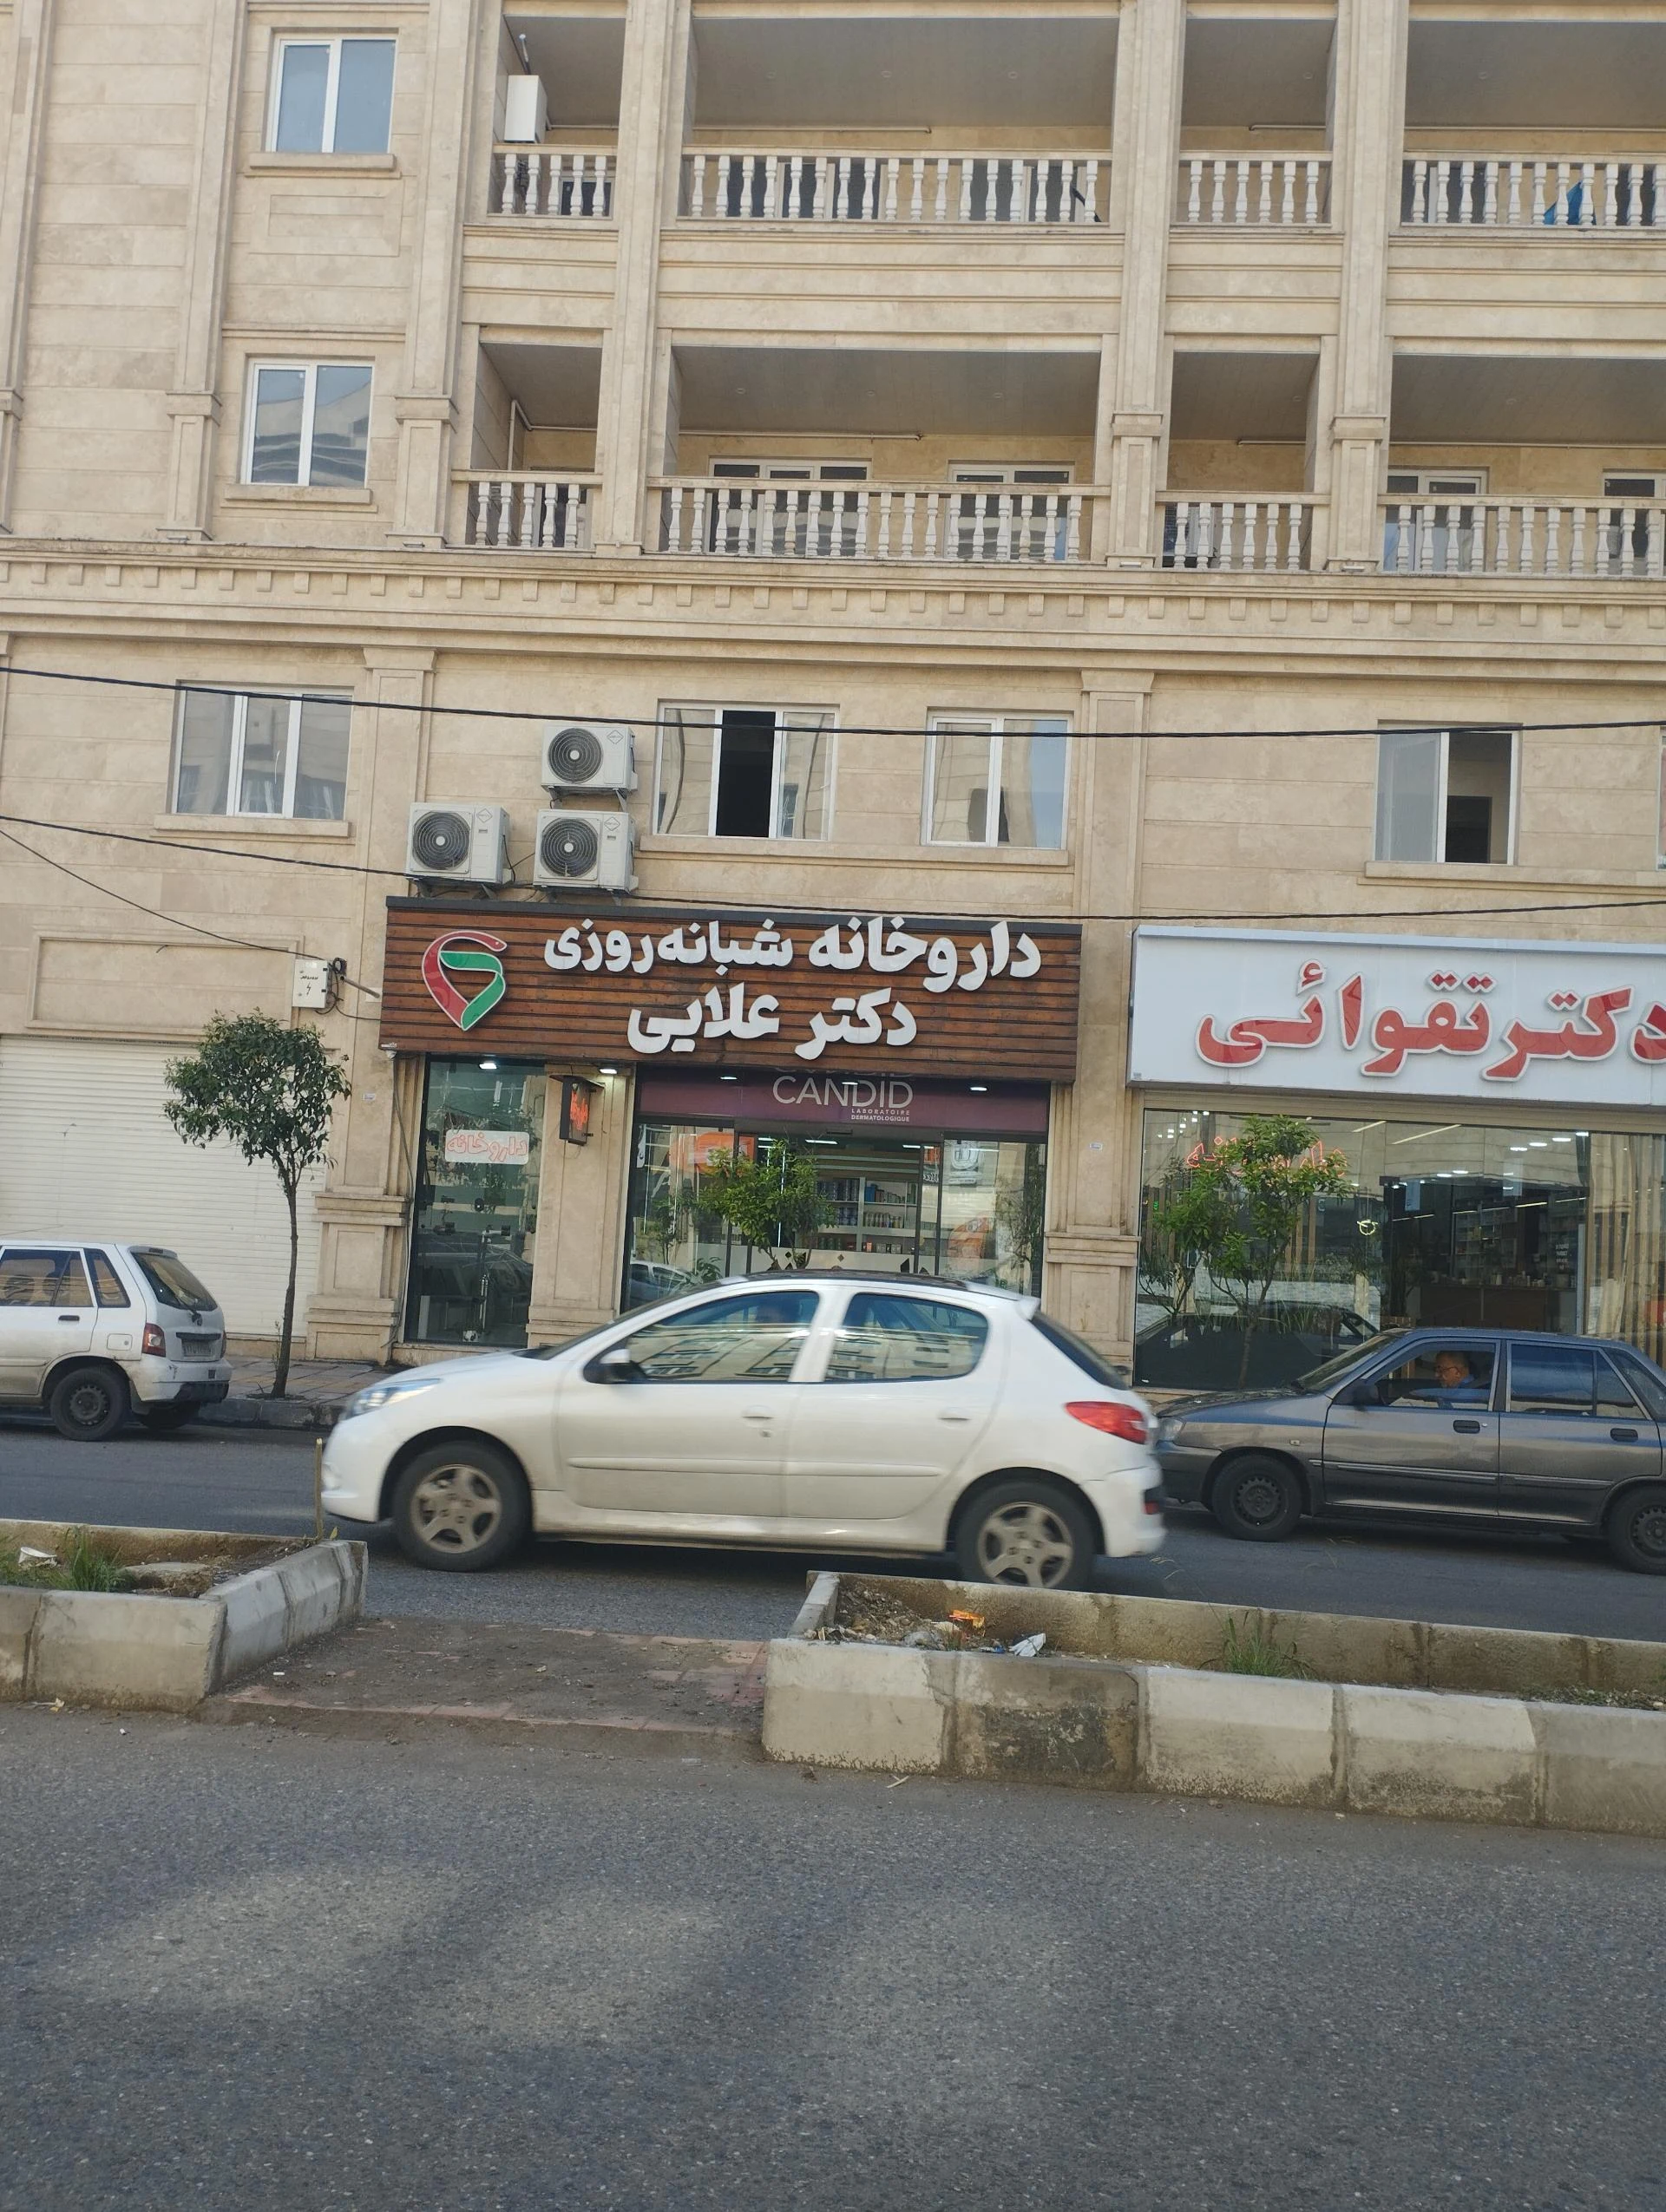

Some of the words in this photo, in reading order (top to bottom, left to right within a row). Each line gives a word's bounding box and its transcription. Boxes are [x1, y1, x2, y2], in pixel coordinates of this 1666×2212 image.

[809, 915, 1041, 993] داروخانه
[627, 982, 780, 1054] علایی
[794, 987, 917, 1060] دکتر
[1195, 959, 1497, 1077] تقوائی
[1481, 985, 1666, 1082] دکتر
[772, 1076, 914, 1109] CANDID
[446, 1131, 528, 1162] داروخانه
